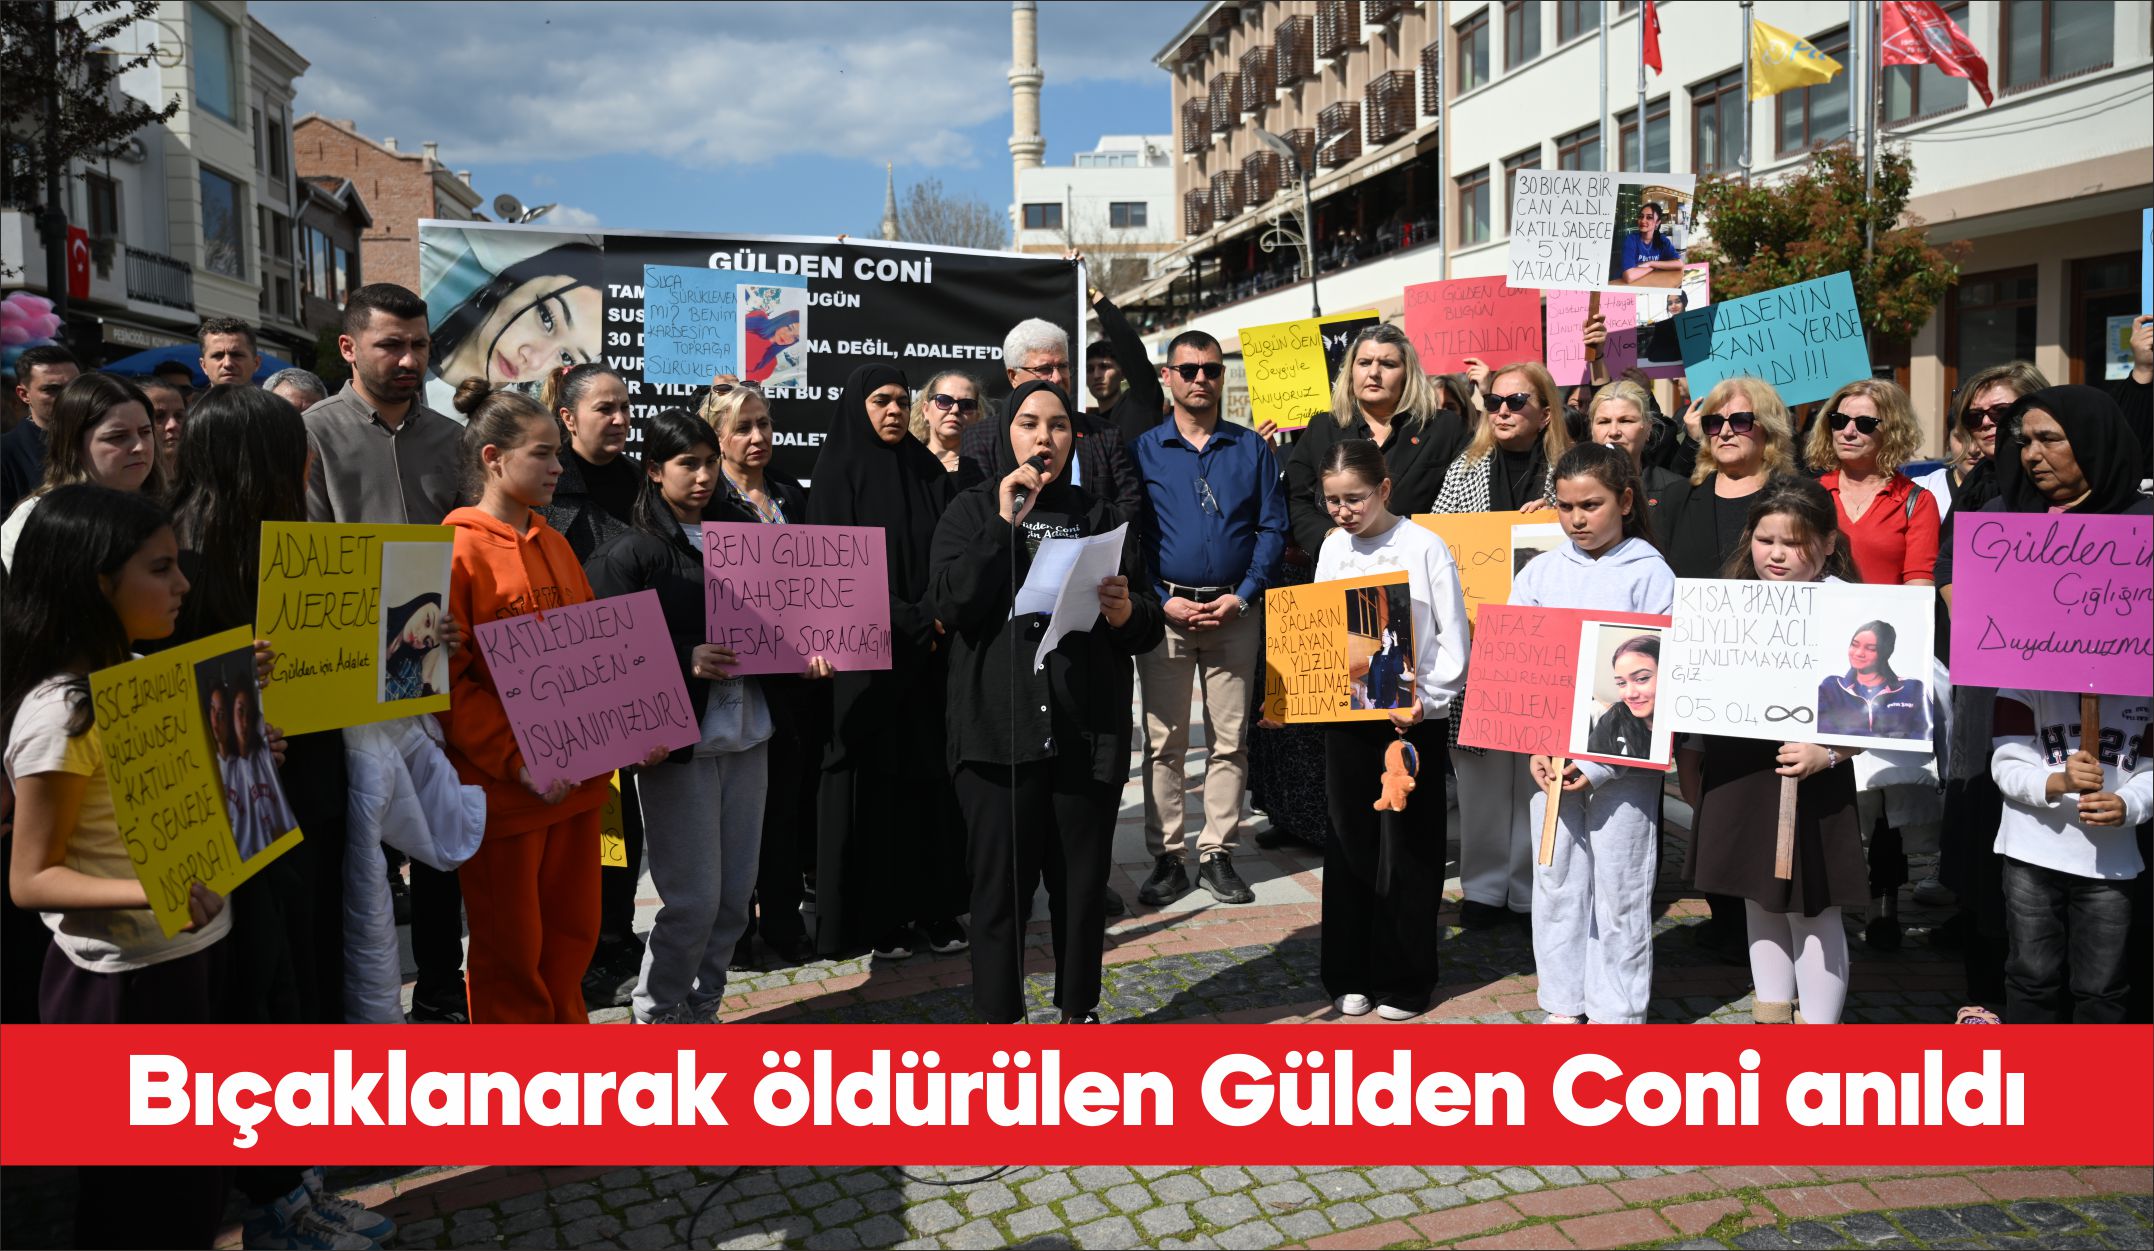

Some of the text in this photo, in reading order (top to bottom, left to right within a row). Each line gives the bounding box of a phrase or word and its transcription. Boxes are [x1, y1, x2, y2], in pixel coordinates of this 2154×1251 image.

[1588, 174, 1612, 198] BİR
[1516, 198, 1552, 216] CAN
[1562, 220, 1612, 240] SADECE
[708, 248, 933, 284] GÜLDEN CONİ
[807, 291, 861, 308] UGÜN
[608, 333, 631, 347] 30
[1709, 308, 1863, 362] KANI YERDE
[837, 338, 899, 360] DEĞİL,
[795, 386, 822, 400] BU
[772, 431, 828, 447] DALET
[263, 531, 376, 582] ADALET
[706, 531, 869, 568] BEN GÜLDEN
[266, 587, 381, 635] NEREDE
[1268, 589, 1299, 615] KISA
[1679, 584, 1819, 616] KISA HAYAT
[708, 624, 785, 660] HESAP
[1266, 630, 1334, 657] PARLAYAN
[336, 646, 371, 673] Adalet
[1266, 673, 1350, 697] UNUTULMAZ
[1272, 694, 1338, 720] GÜLÜM
